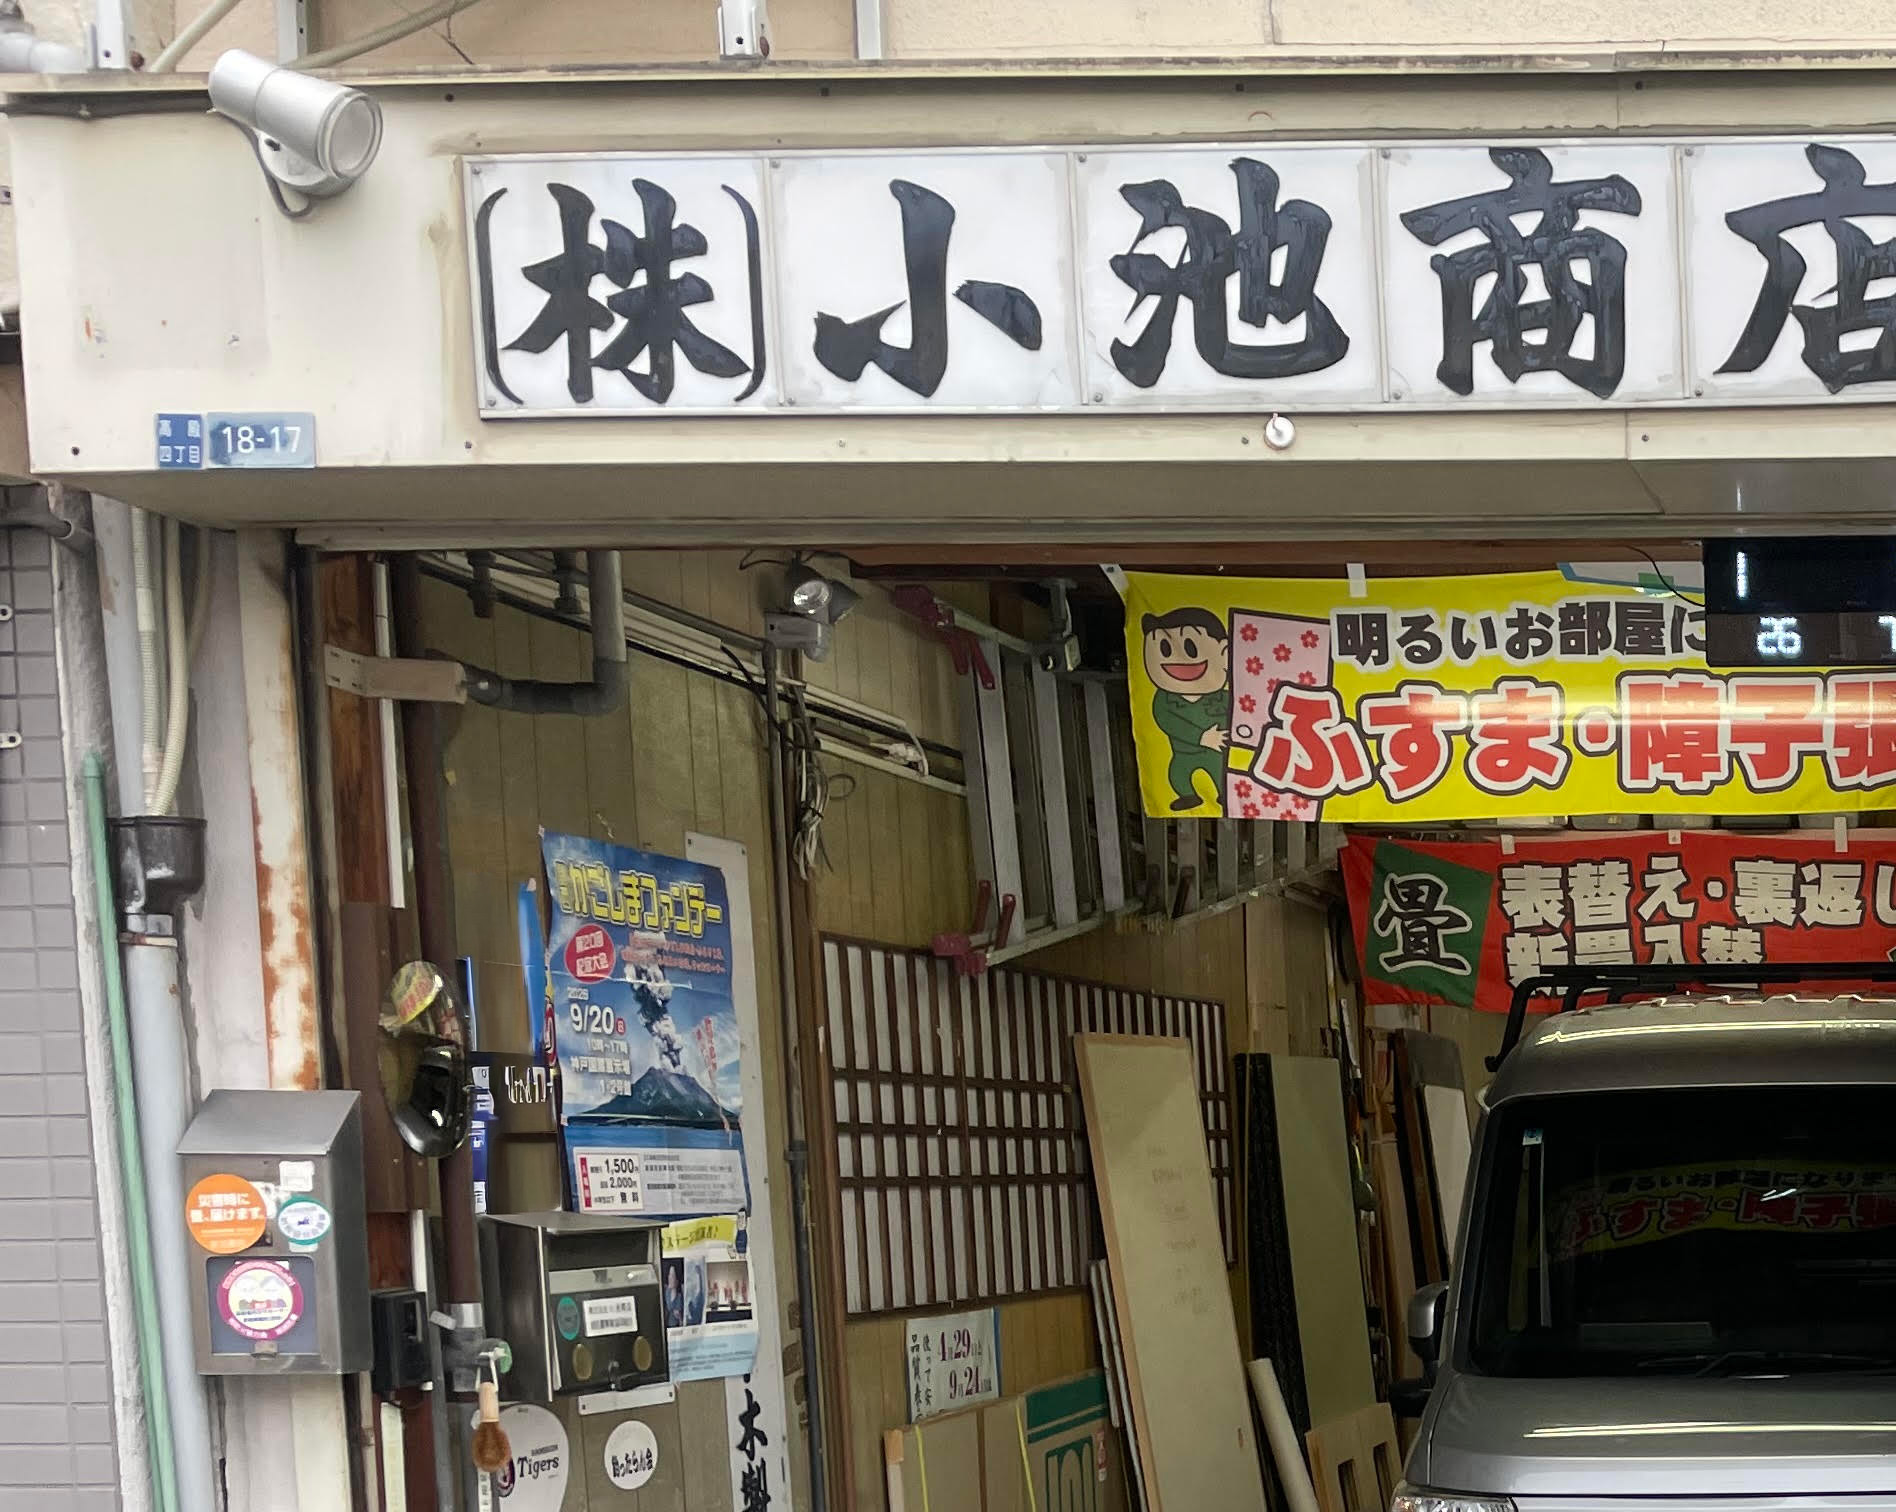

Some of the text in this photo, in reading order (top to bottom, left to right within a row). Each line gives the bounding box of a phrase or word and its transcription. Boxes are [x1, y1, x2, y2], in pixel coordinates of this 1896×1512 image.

[221, 425, 302, 454] 18-17
[1374, 871, 1472, 976] 畳
[570, 1003, 615, 1035] 9/20
[517, 1455, 560, 1480] Tigers
